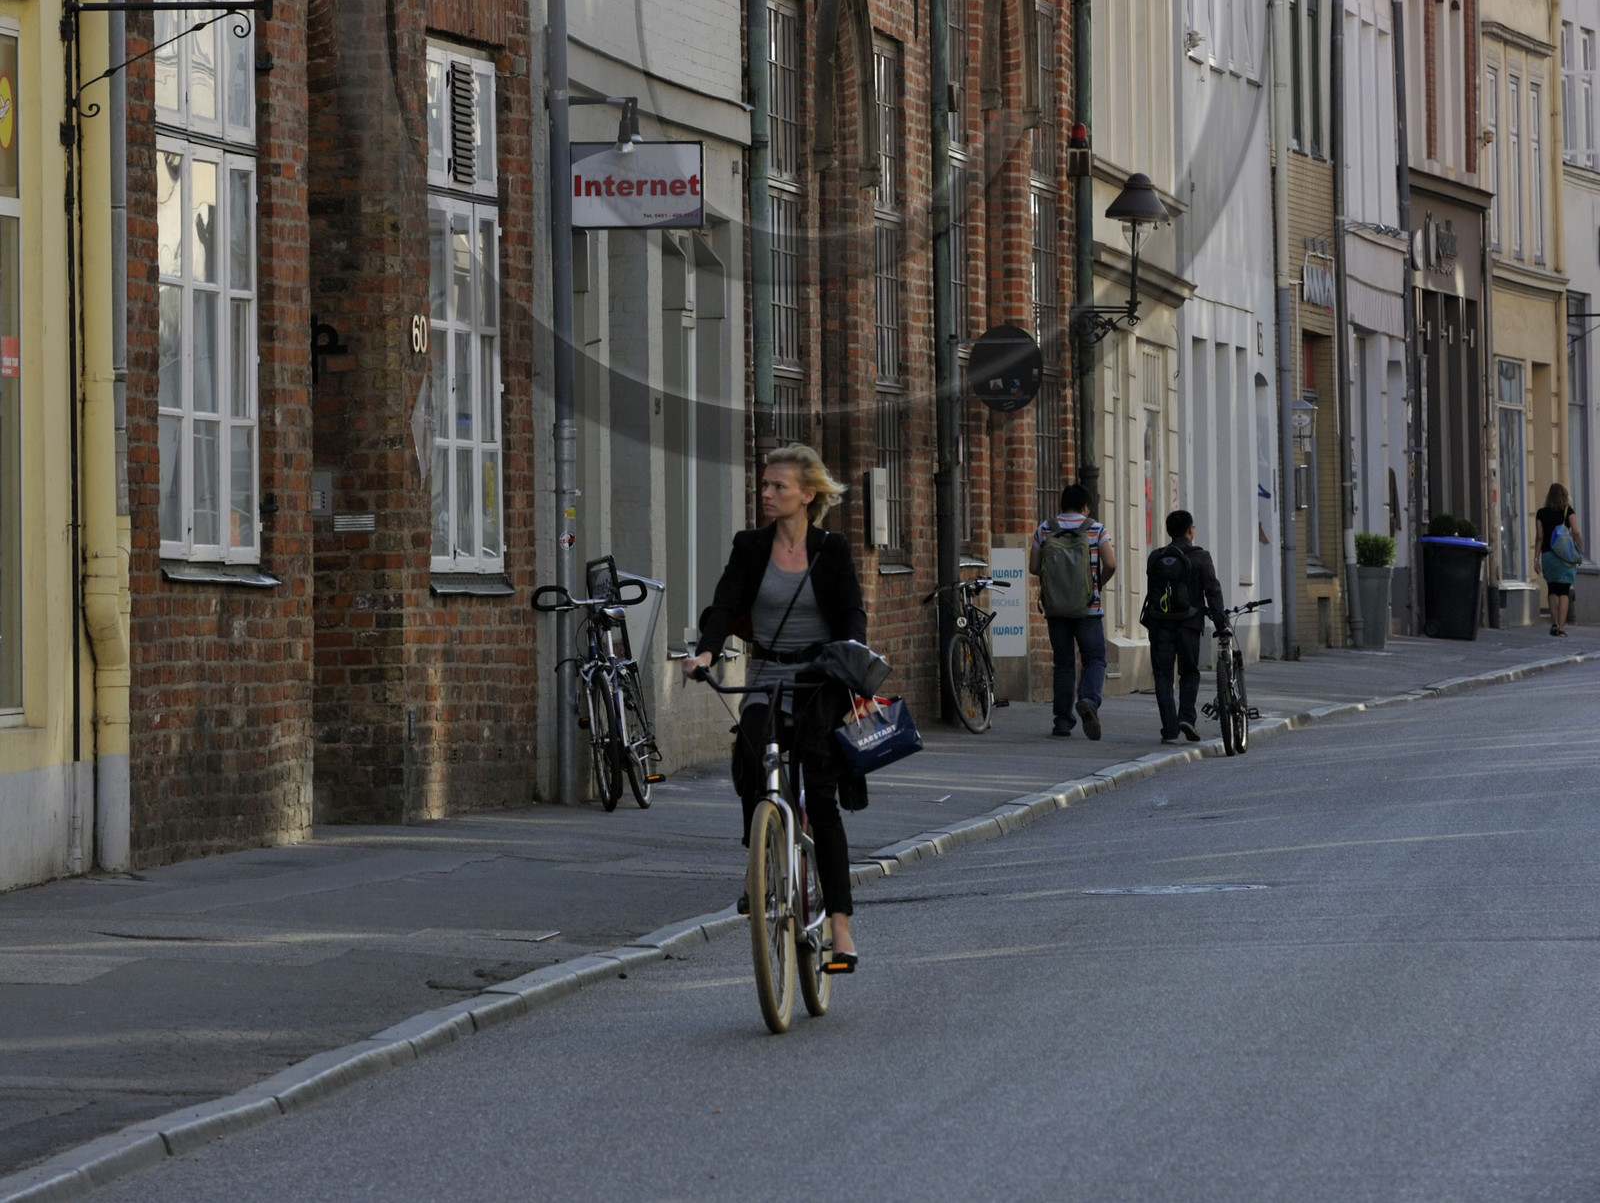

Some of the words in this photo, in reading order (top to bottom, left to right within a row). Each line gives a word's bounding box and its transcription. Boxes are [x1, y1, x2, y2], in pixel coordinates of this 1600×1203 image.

[574, 174, 700, 197] Internet
[412, 314, 428, 354] 60
[857, 724, 896, 747] KARSTADT
